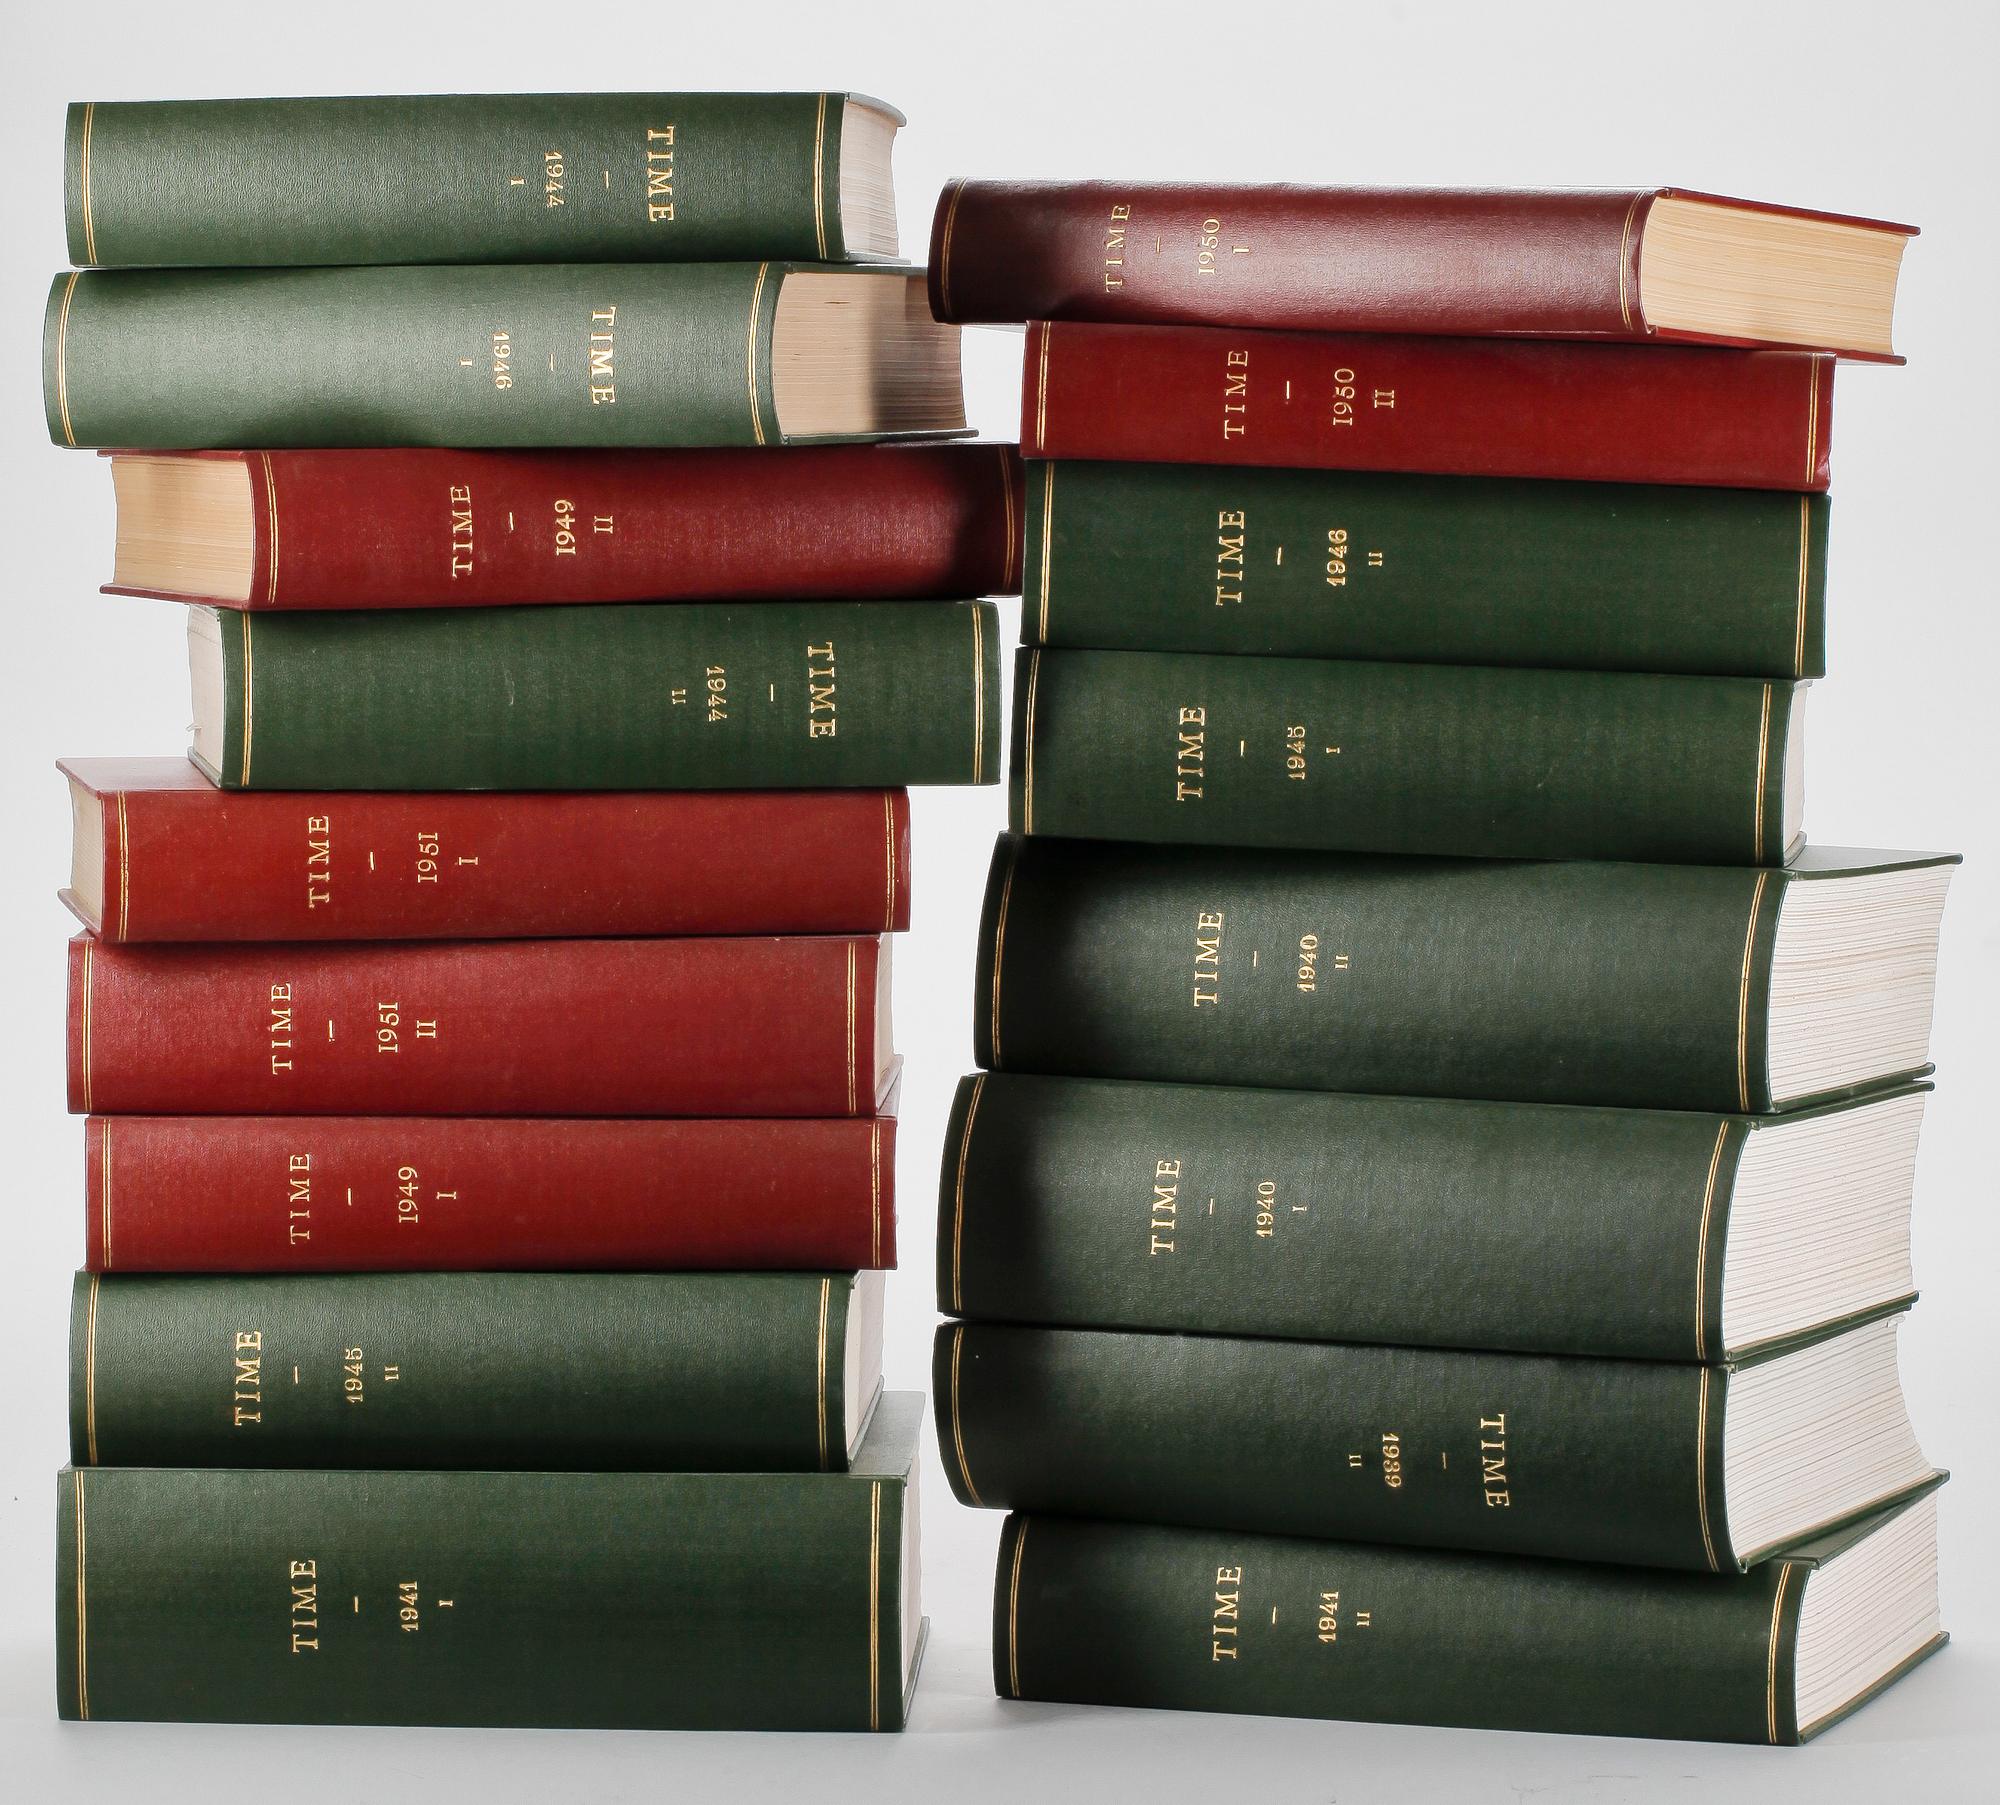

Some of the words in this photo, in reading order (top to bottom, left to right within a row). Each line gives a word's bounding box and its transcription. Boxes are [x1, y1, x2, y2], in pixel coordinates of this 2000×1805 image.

[510, 178, 525, 186] I
[544, 151, 565, 208] 1944
[646, 125, 675, 222] TIME
[1105, 205, 1131, 293] TIME
[1197, 218, 1220, 276] 1950
[1232, 246, 1249, 255] I
[459, 358, 473, 367] I
[492, 332, 513, 390] 1946
[589, 306, 617, 405] TIME
[1223, 350, 1249, 440] TIME
[1332, 368, 1356, 426] 1950
[1373, 389, 1395, 409] II
[449, 485, 474, 579] TIME
[554, 499, 577, 557] 1949
[593, 515, 614, 534] II
[1215, 510, 1245, 607] TIME
[1326, 529, 1348, 587] 1946
[1368, 551, 1383, 567] II
[671, 688, 687, 705] II
[706, 665, 728, 722] 1944
[807, 641, 836, 738] TIME
[1176, 706, 1206, 802] TIME
[1286, 725, 1306, 780] 1945
[307, 815, 331, 909] TIME
[458, 856, 479, 866] I
[1193, 911, 1223, 1007] TIME
[1296, 933, 1318, 993] 1940
[1334, 955, 1349, 970] II
[267, 982, 293, 1076] TIME
[416, 1019, 437, 1039] II
[289, 1153, 315, 1245] TIME
[397, 1166, 419, 1224] 1949
[435, 1191, 457, 1200] I
[1150, 1159, 1181, 1256] TIME
[1256, 1181, 1277, 1238] 1940
[233, 1326, 264, 1426] TIME
[343, 1347, 364, 1404] 1945
[384, 1365, 400, 1381] II
[1348, 1454, 1362, 1468] II
[1382, 1432, 1402, 1488] 1939
[1480, 1413, 1510, 1507] TIME
[290, 1559, 319, 1653] TIME
[399, 1581, 419, 1632] 1941
[438, 1599, 454, 1607] I
[1212, 1566, 1242, 1662] TIME
[1318, 1591, 1339, 1643] 1941
[1356, 1611, 1371, 1627] II
